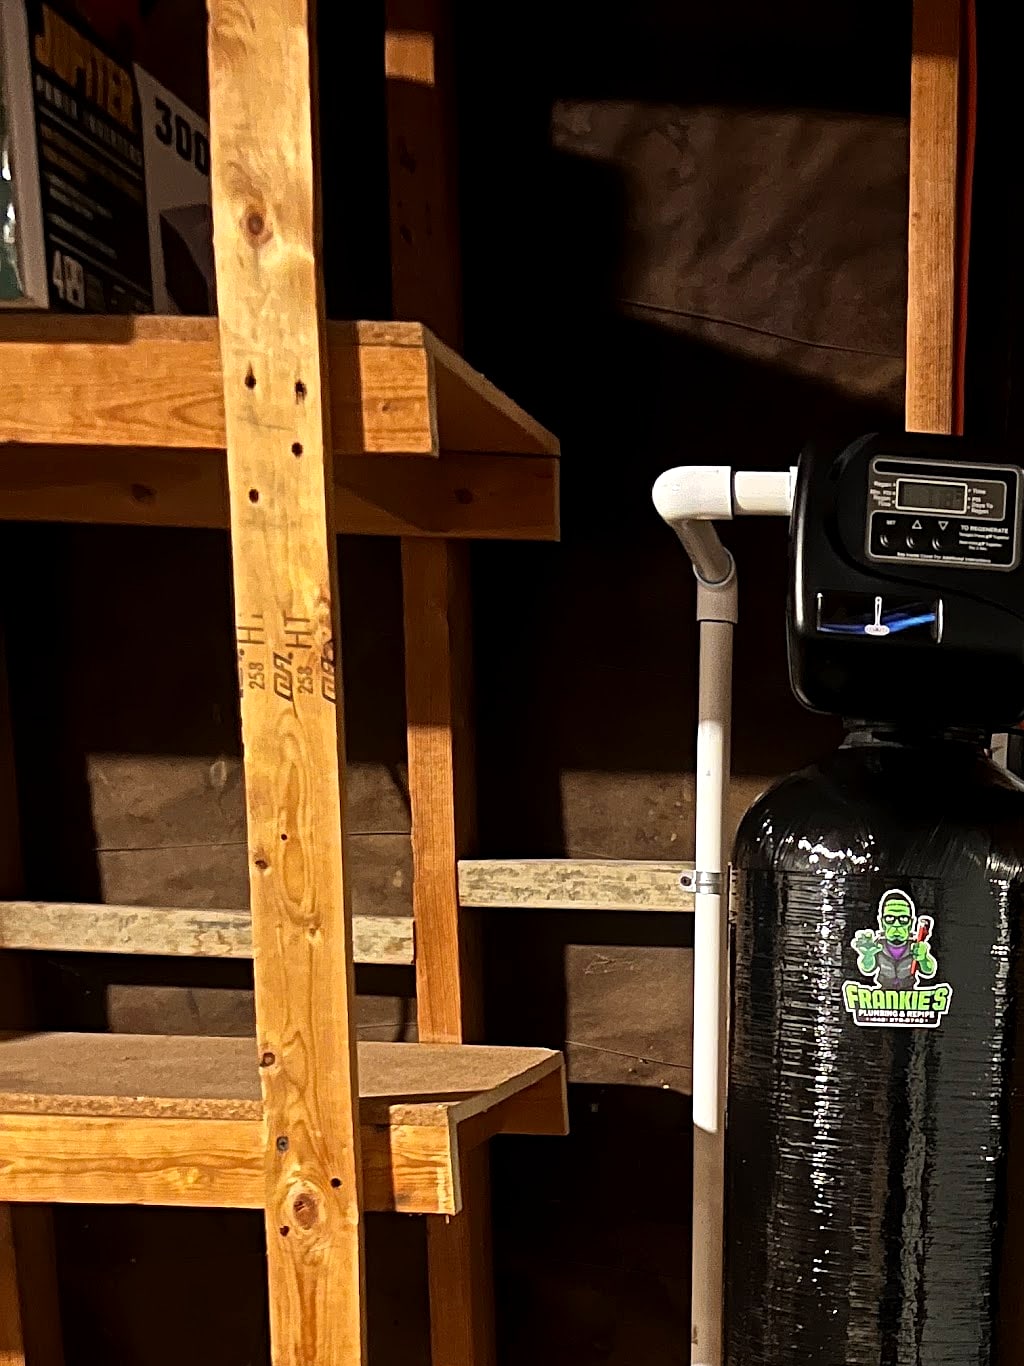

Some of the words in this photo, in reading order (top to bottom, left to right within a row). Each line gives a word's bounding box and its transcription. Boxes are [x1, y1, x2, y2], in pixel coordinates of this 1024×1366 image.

[282, 610, 313, 649] HT
[248, 662, 266, 690] 258
[296, 665, 314, 695] 258
[845, 984, 949, 1011] FRANKIE'S
[858, 1009, 898, 1017] PLUMBING
